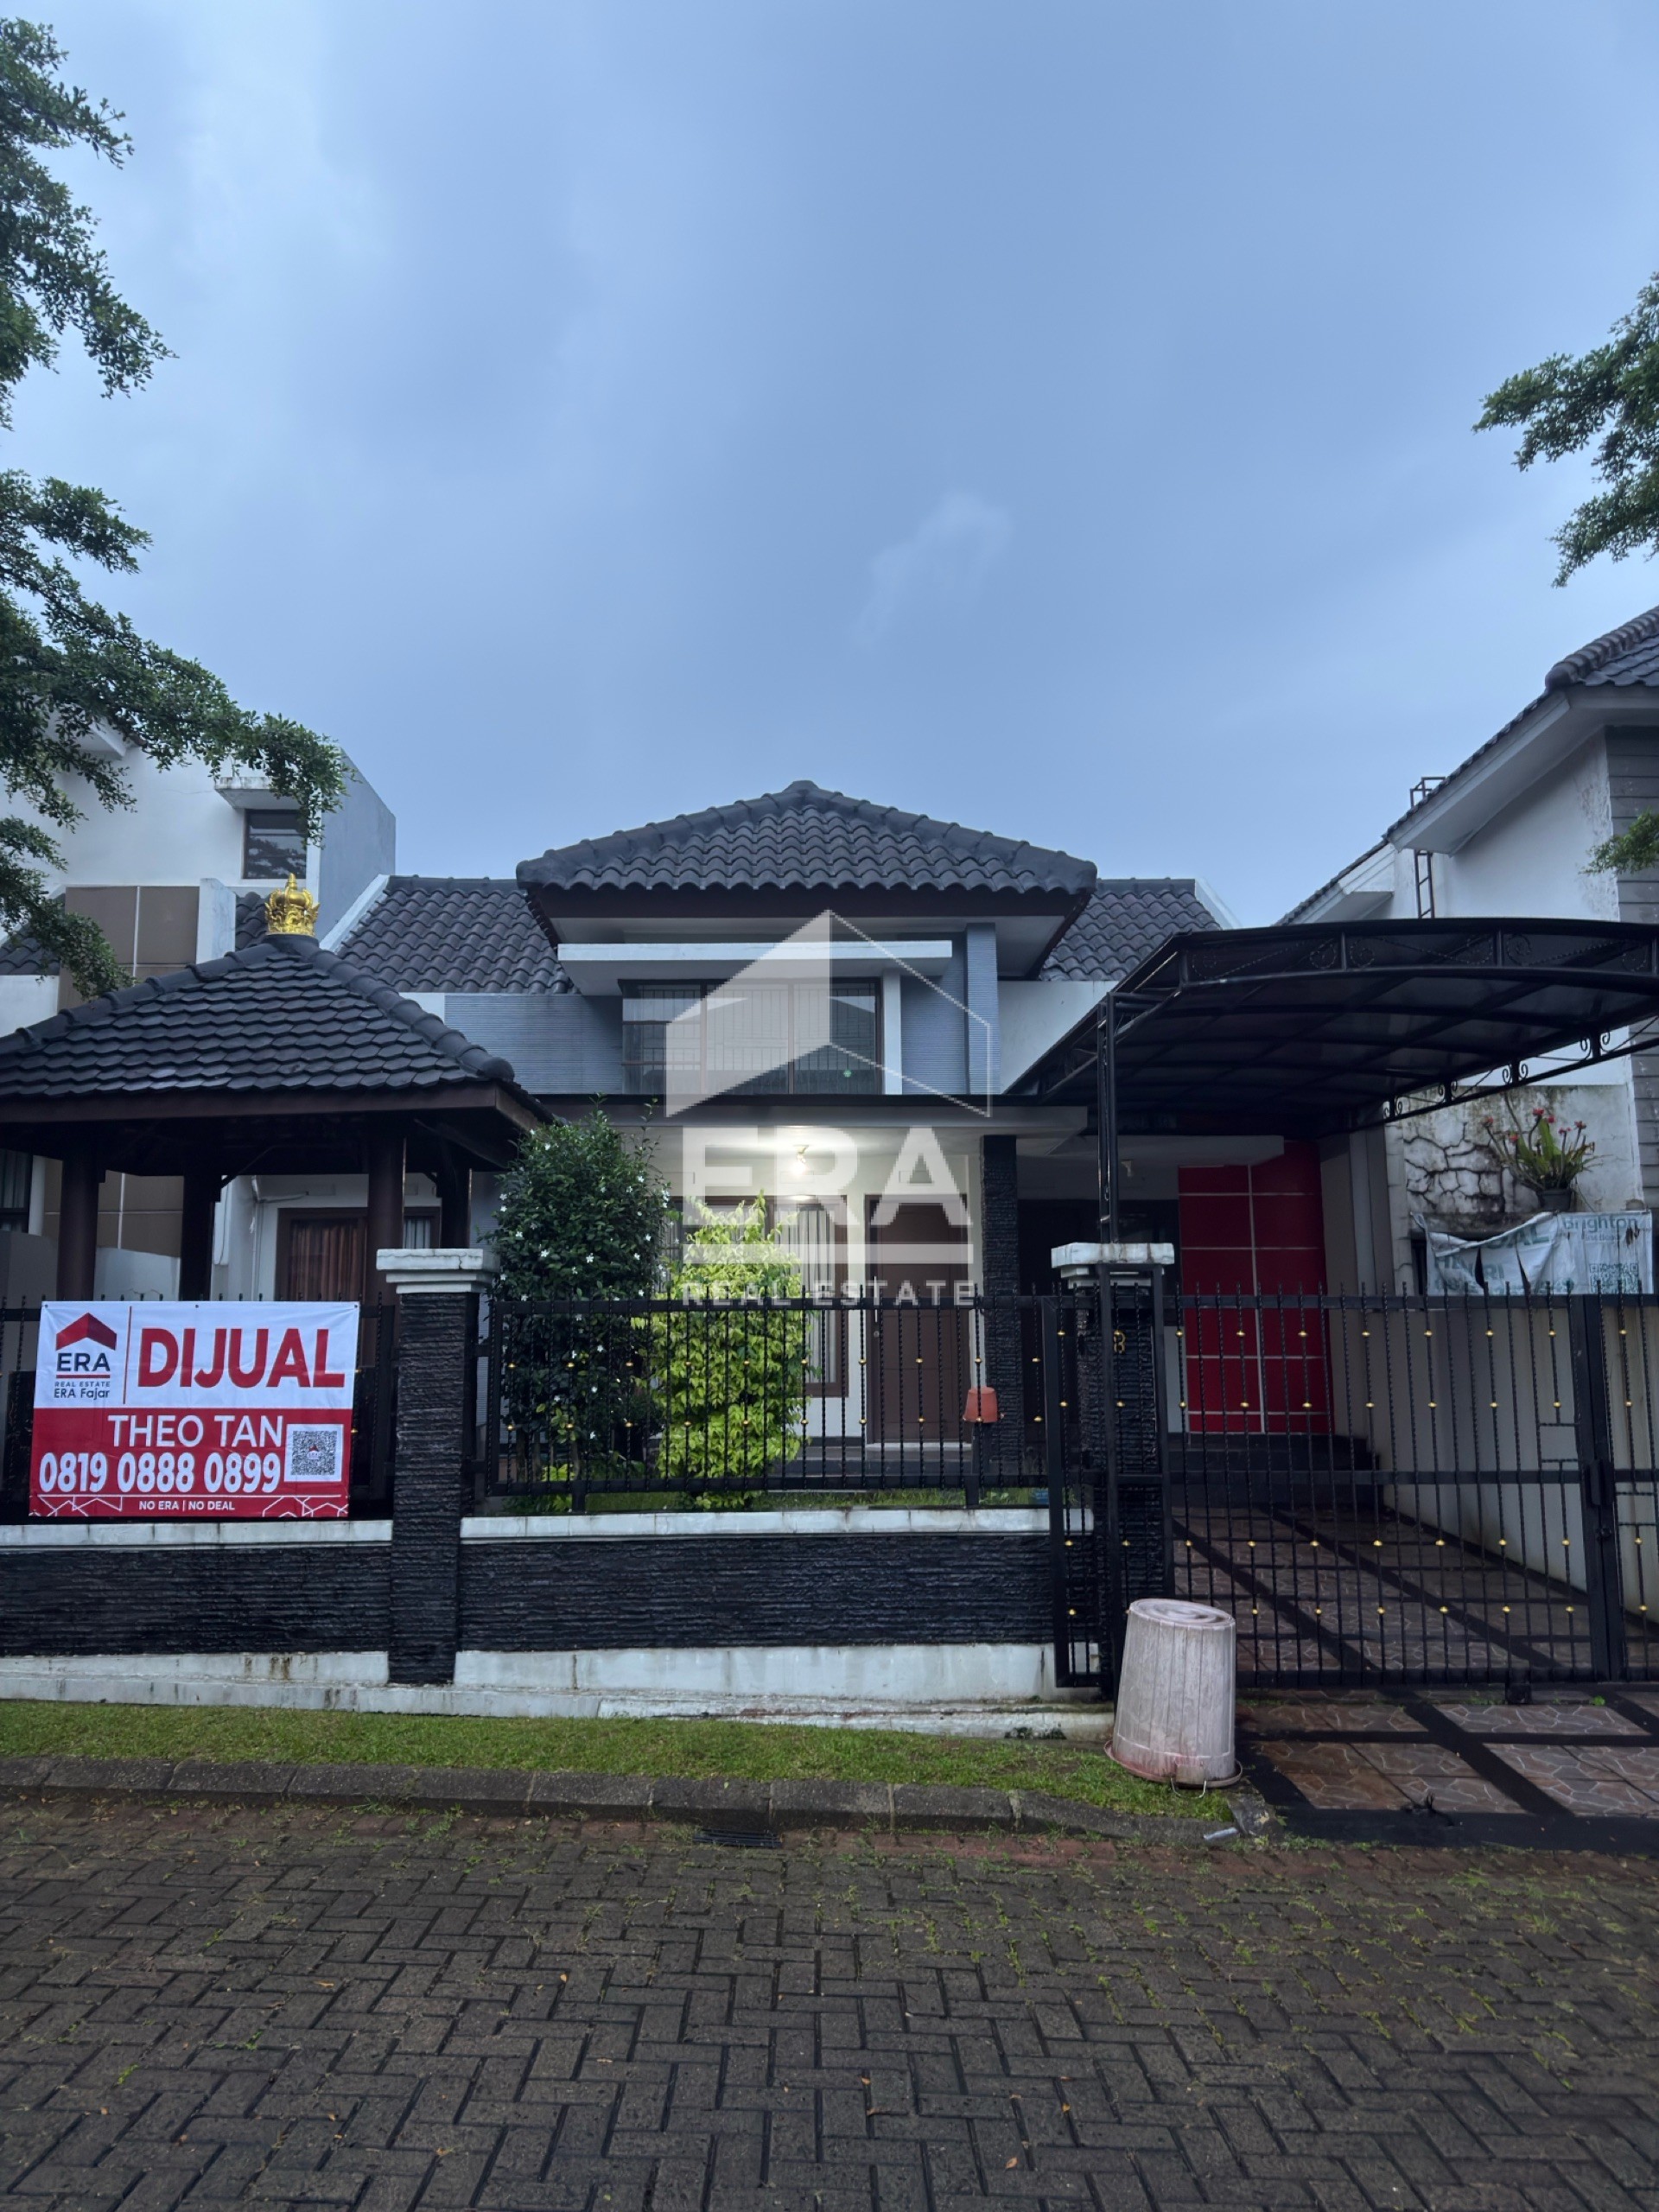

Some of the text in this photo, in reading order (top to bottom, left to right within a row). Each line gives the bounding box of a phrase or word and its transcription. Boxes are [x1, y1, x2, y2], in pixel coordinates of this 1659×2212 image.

[56, 1352, 111, 1372] ERA
[137, 1328, 346, 1388] DIJUAL
[54, 1388, 110, 1400] ERA Fajar
[107, 1414, 283, 1448] THEO TAN
[39, 1452, 281, 1493] 0819 0888 0899
[138, 1501, 235, 1510] NO ERA NO DEAL
